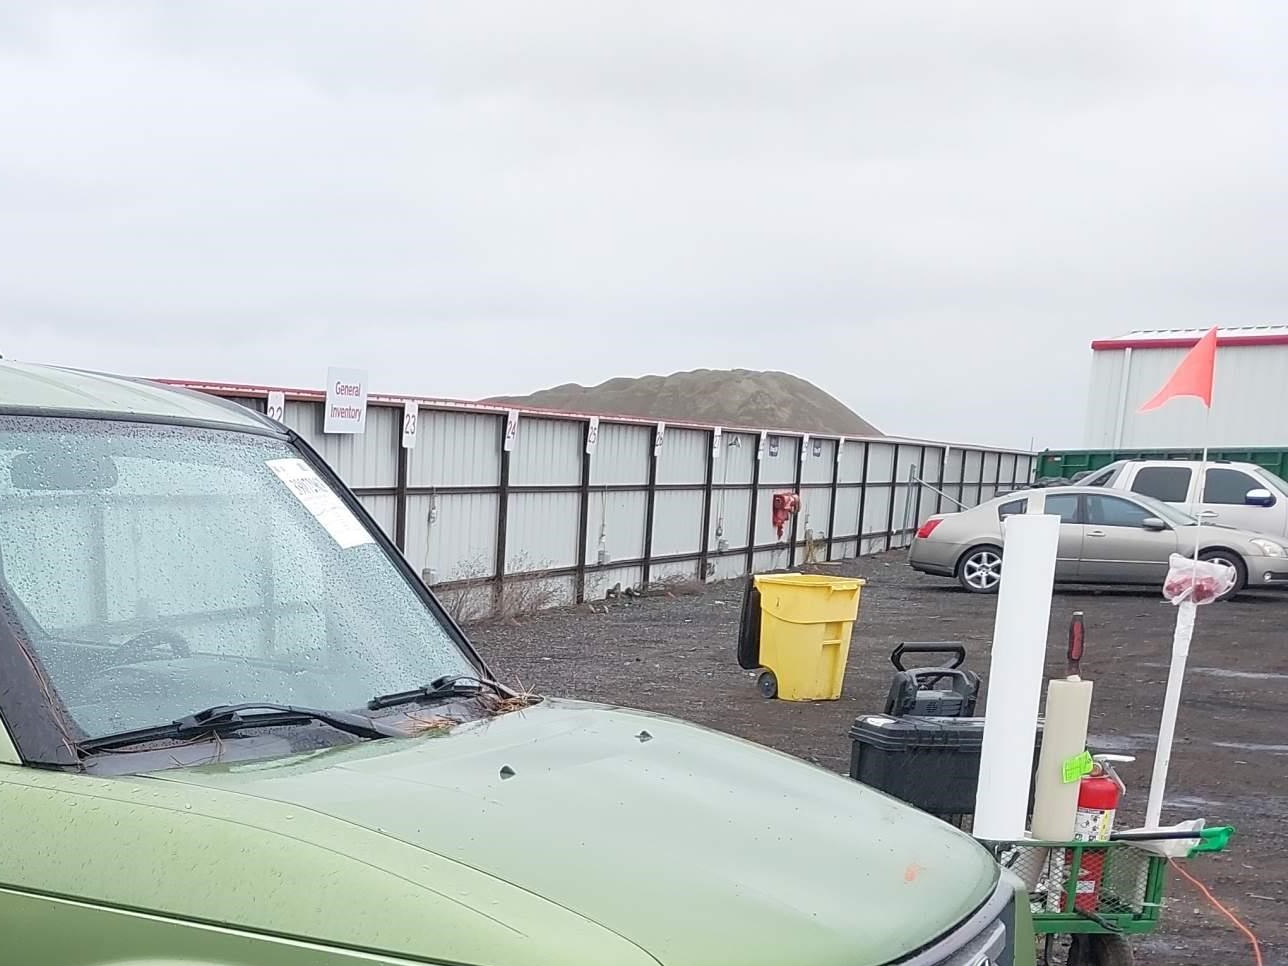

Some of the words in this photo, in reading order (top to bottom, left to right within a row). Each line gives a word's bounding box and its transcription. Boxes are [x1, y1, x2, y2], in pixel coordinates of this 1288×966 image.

[335, 381, 361, 397] General
[330, 403, 362, 422] Inventory
[404, 413, 416, 435] 23
[506, 420, 517, 439] 24
